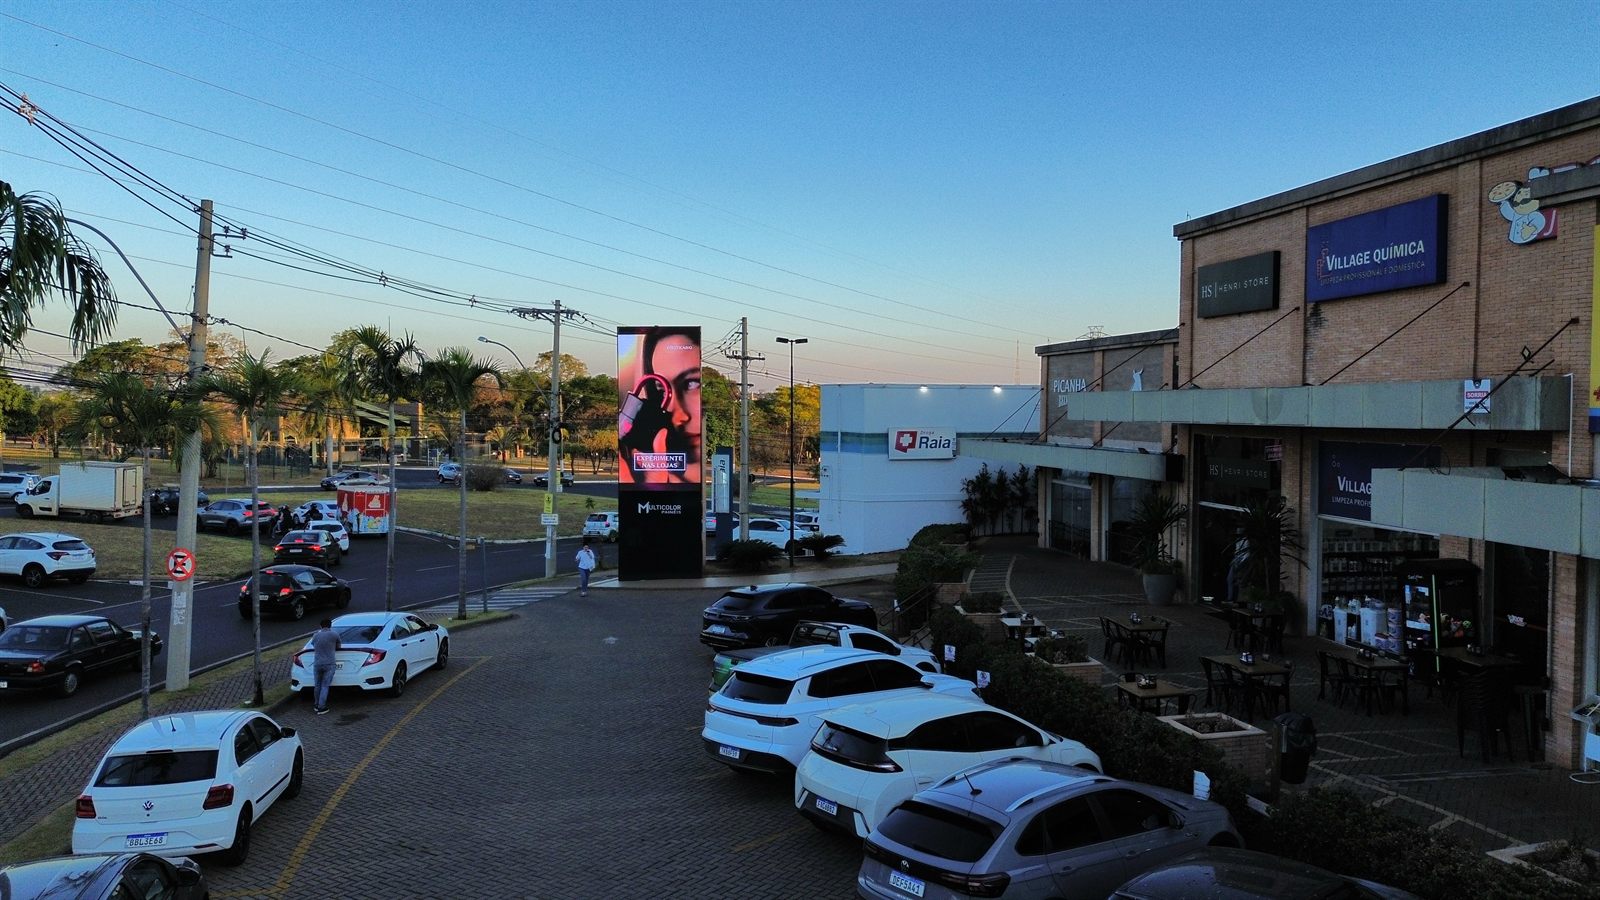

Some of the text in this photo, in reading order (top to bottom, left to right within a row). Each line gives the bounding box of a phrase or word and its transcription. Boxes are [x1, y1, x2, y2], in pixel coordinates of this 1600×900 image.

[1326, 240, 1425, 271] VILLAGE QUÍMICA
[1202, 276, 1269, 298] HS HENRI STORE
[1053, 378, 1087, 393] PICANHA
[919, 436, 951, 449] Raia
[1337, 475, 1372, 495] VILLAG
[638, 501, 681, 513] MULTICOLOR
[1332, 496, 1354, 505] LIMPEZA
